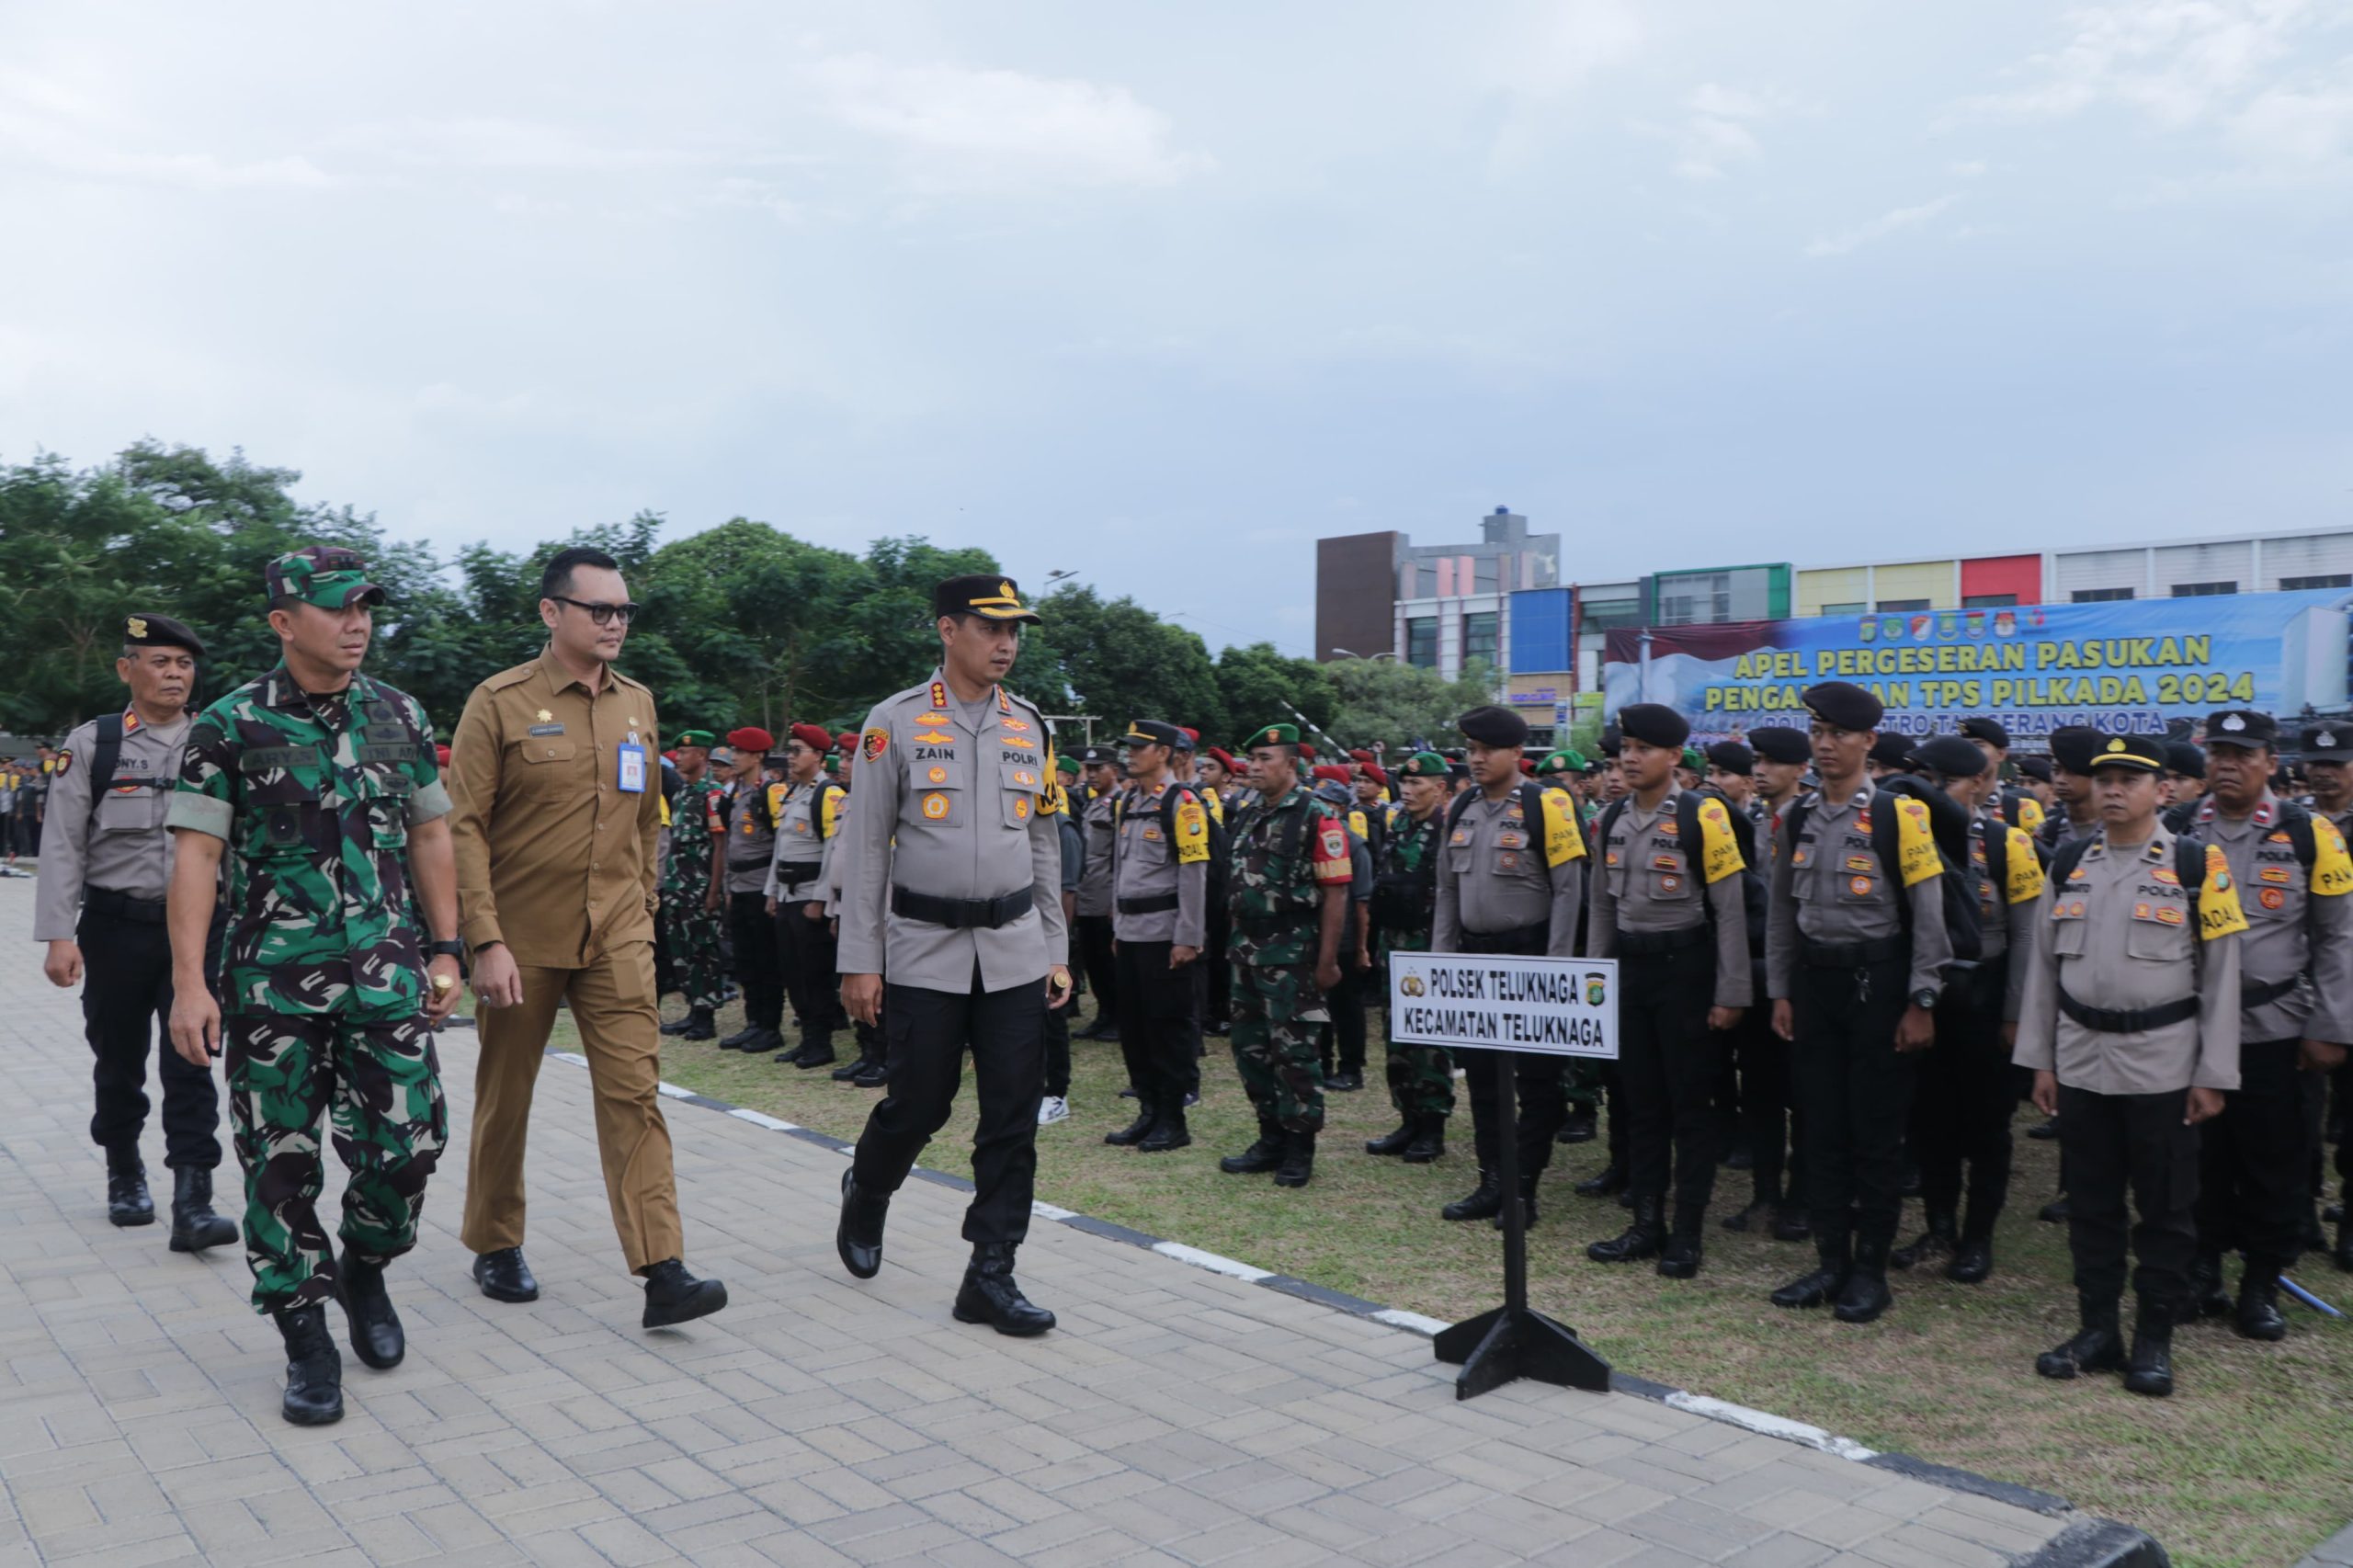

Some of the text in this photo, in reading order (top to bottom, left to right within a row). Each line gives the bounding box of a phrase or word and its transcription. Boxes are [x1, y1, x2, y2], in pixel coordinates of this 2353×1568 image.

[1734, 634, 2211, 678] APEL PERGESERAN PASUKAN
[1921, 679, 1981, 708] TPS
[1992, 675, 2147, 706] PILKADA
[2157, 672, 2254, 705] 2024
[2096, 710, 2166, 734] KOTA
[369, 747, 390, 760] TNI
[915, 747, 955, 760] ZAIN
[1002, 751, 1038, 767] POLRI
[1430, 968, 1579, 1005] POLSEK TELUKNAGA
[1404, 1007, 1605, 1048] KECAMATAN TELUKNAGA
